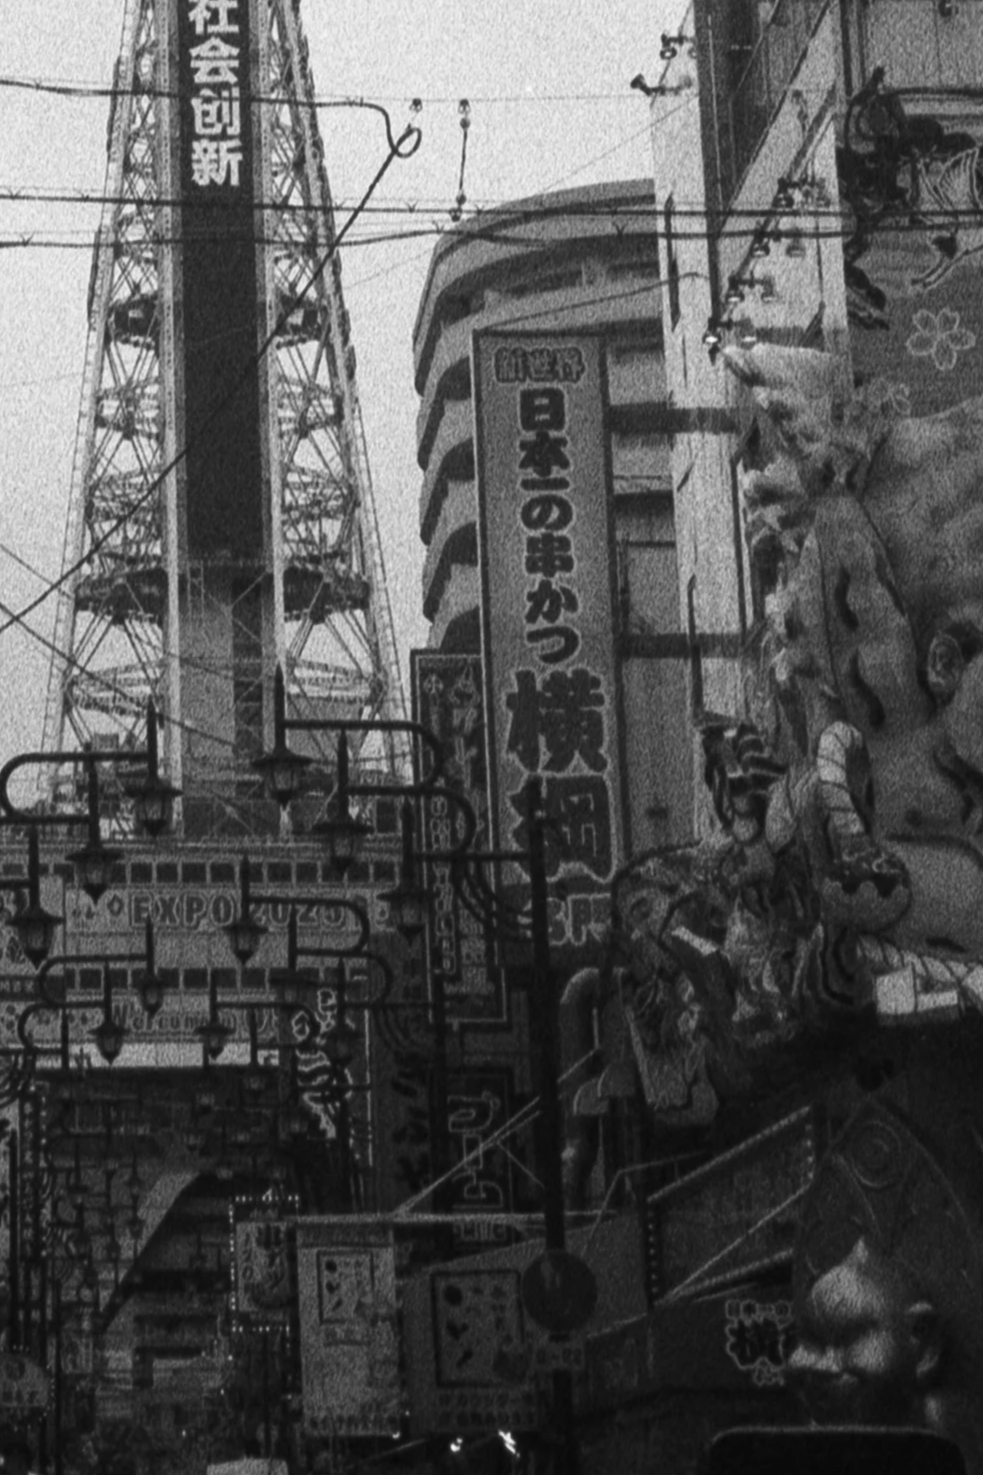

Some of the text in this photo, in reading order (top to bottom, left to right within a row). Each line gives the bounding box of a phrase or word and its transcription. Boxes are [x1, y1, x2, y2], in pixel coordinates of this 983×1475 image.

[517, 387, 581, 665] 日本一の串かつ
[504, 668, 615, 884] 横綱
[130, 892, 238, 928] EXPO
